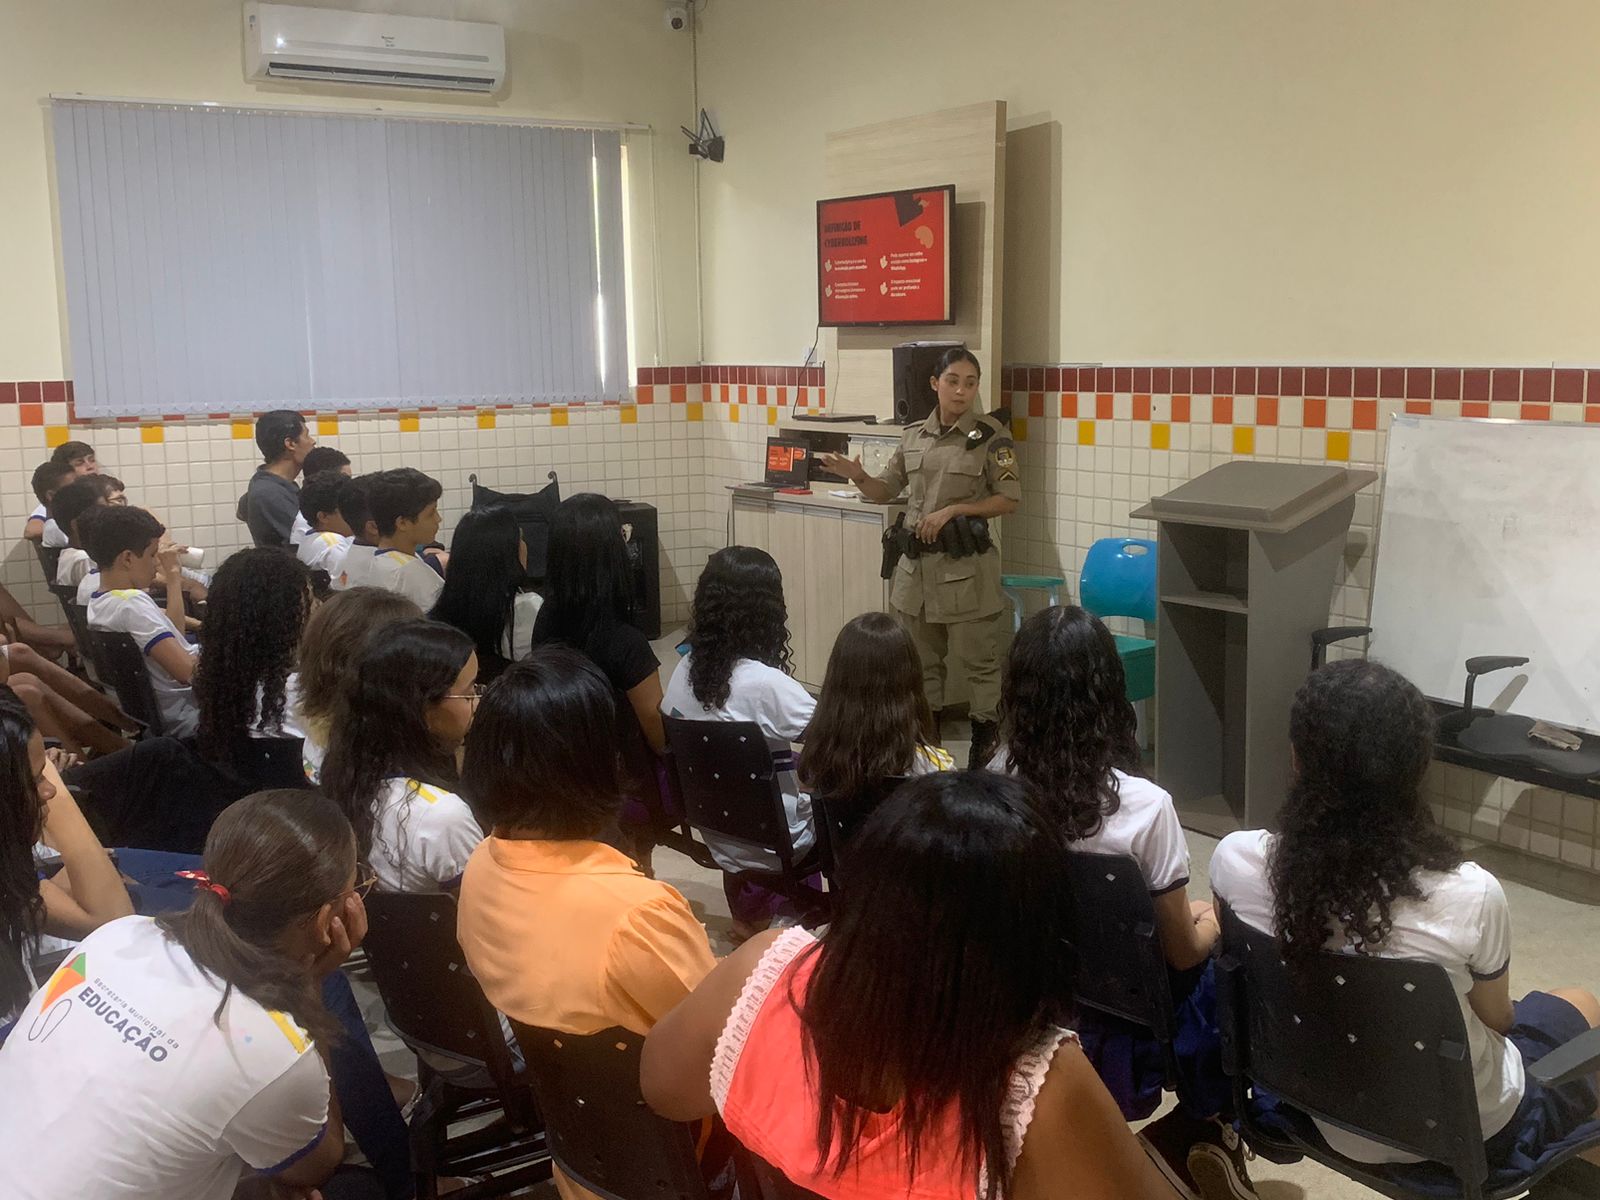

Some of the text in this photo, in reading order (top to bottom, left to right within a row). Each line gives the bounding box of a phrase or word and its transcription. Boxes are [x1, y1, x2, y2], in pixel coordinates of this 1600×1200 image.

[78, 986, 168, 1062] EDUCAÇÃO
[94, 978, 128, 1009] Secretaria
[128, 1007, 167, 1038] Municipal
